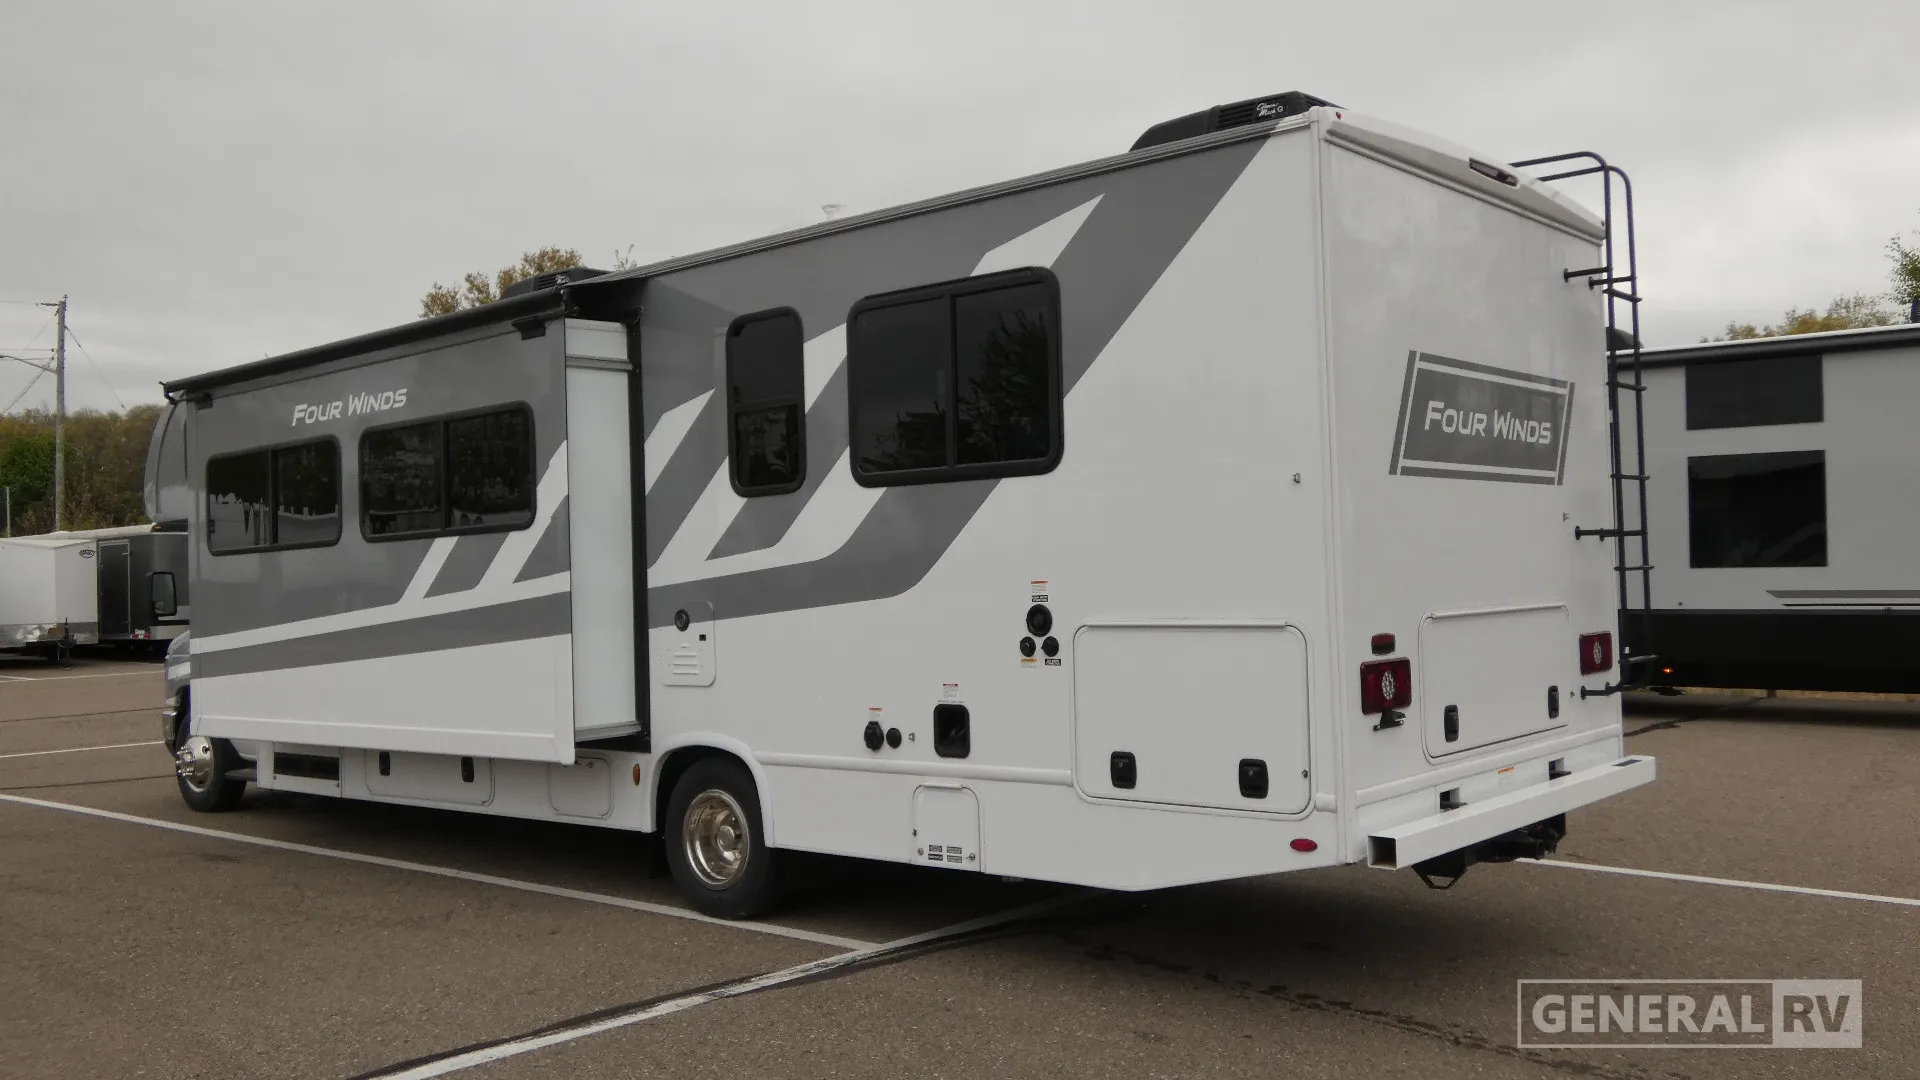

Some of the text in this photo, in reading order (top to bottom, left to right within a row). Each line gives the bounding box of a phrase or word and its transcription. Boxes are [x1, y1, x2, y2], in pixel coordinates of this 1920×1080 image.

[291, 388, 408, 427] FOUR WINDS
[1424, 400, 1551, 445] FOUR WINDS
